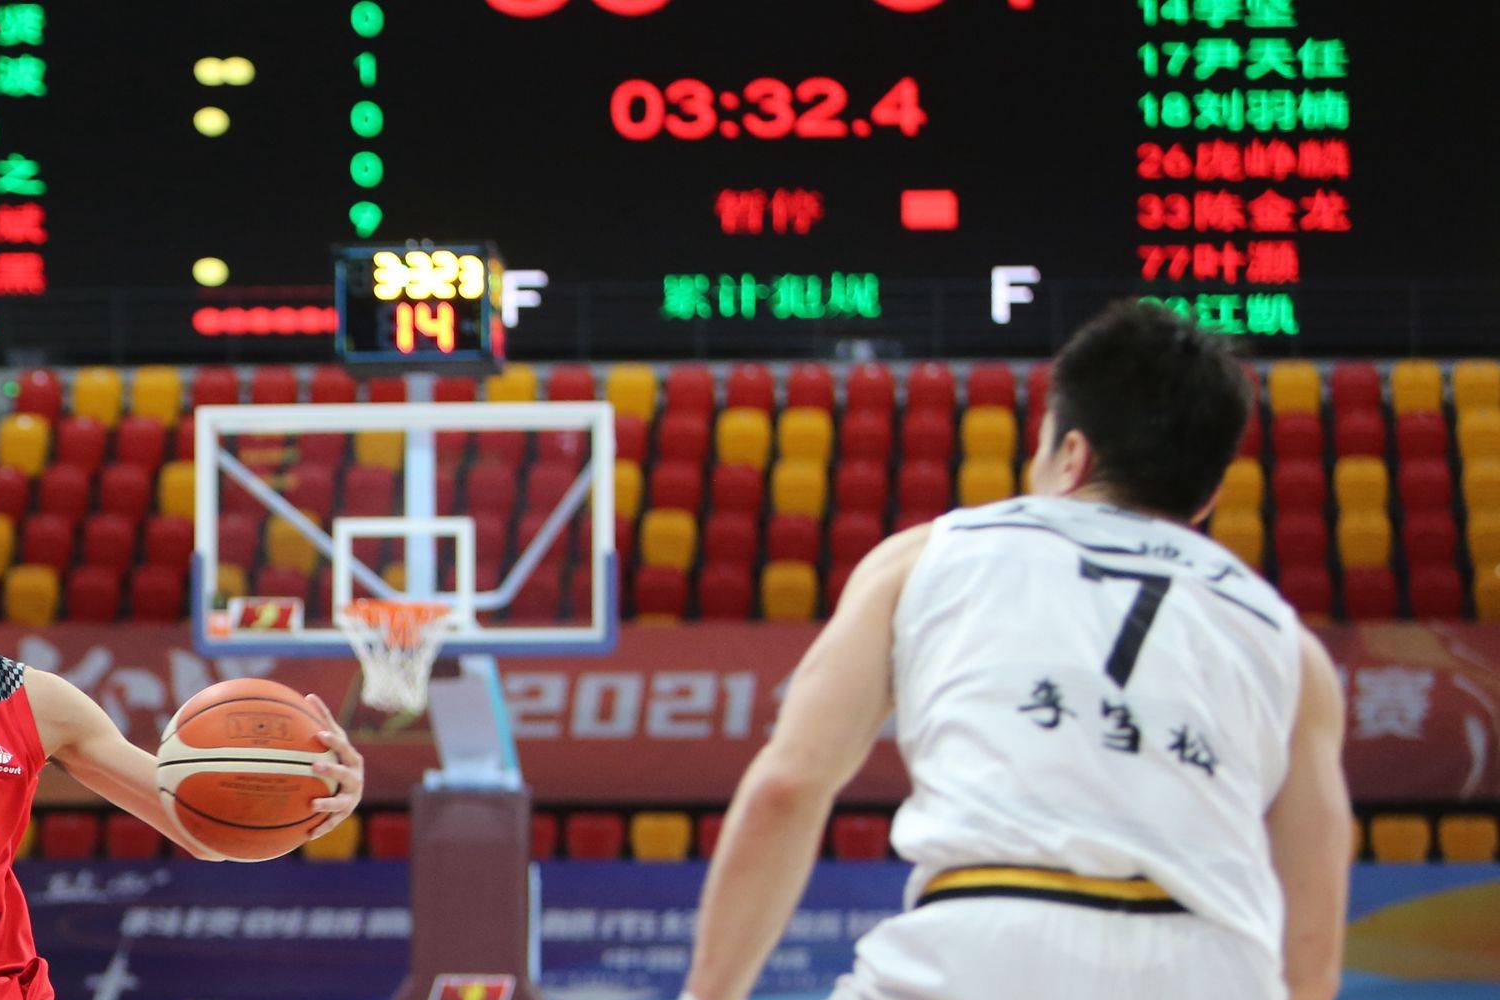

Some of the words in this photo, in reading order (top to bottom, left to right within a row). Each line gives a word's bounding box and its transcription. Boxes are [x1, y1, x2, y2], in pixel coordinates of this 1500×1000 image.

[610, 77, 928, 140] 03:32.4
[501, 269, 548, 329] F
[991, 266, 1041, 324] F
[396, 301, 454, 353] 14
[1080, 556, 1172, 690] 7
